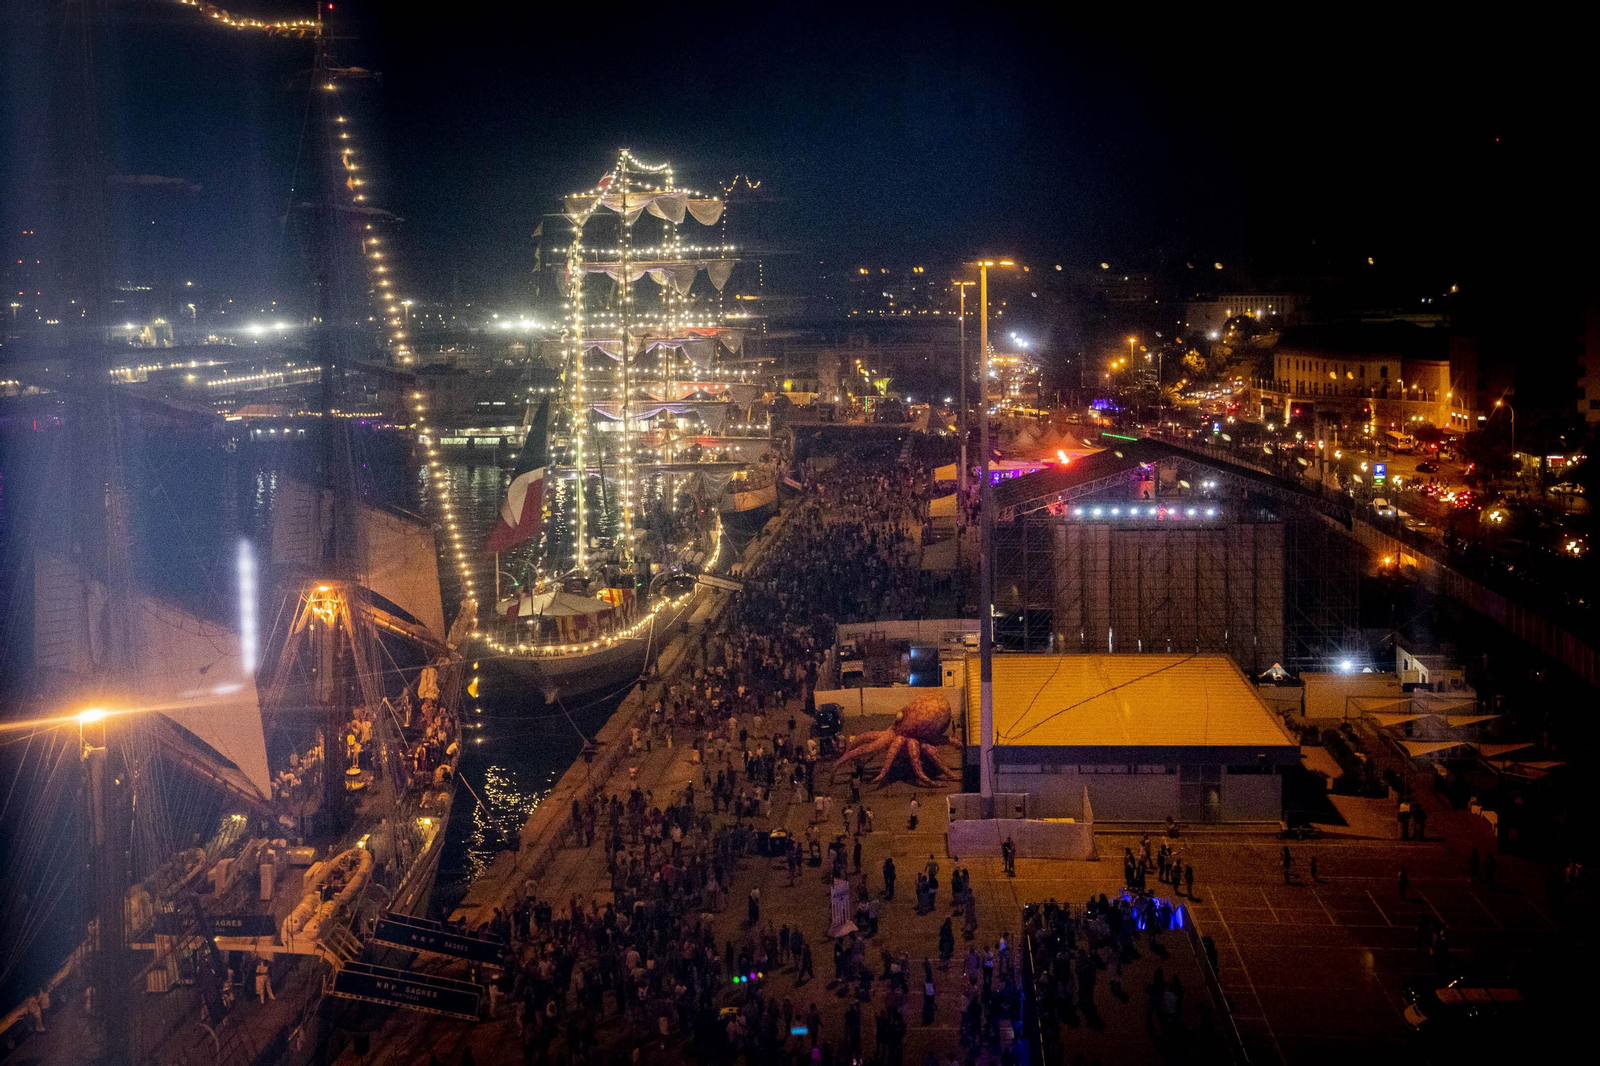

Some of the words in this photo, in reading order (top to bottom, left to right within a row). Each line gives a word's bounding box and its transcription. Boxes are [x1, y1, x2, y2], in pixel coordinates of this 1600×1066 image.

[1376, 465, 1382, 473] P
[444, 941, 469, 952] SAGRES
[405, 986, 438, 998] SAGRES
